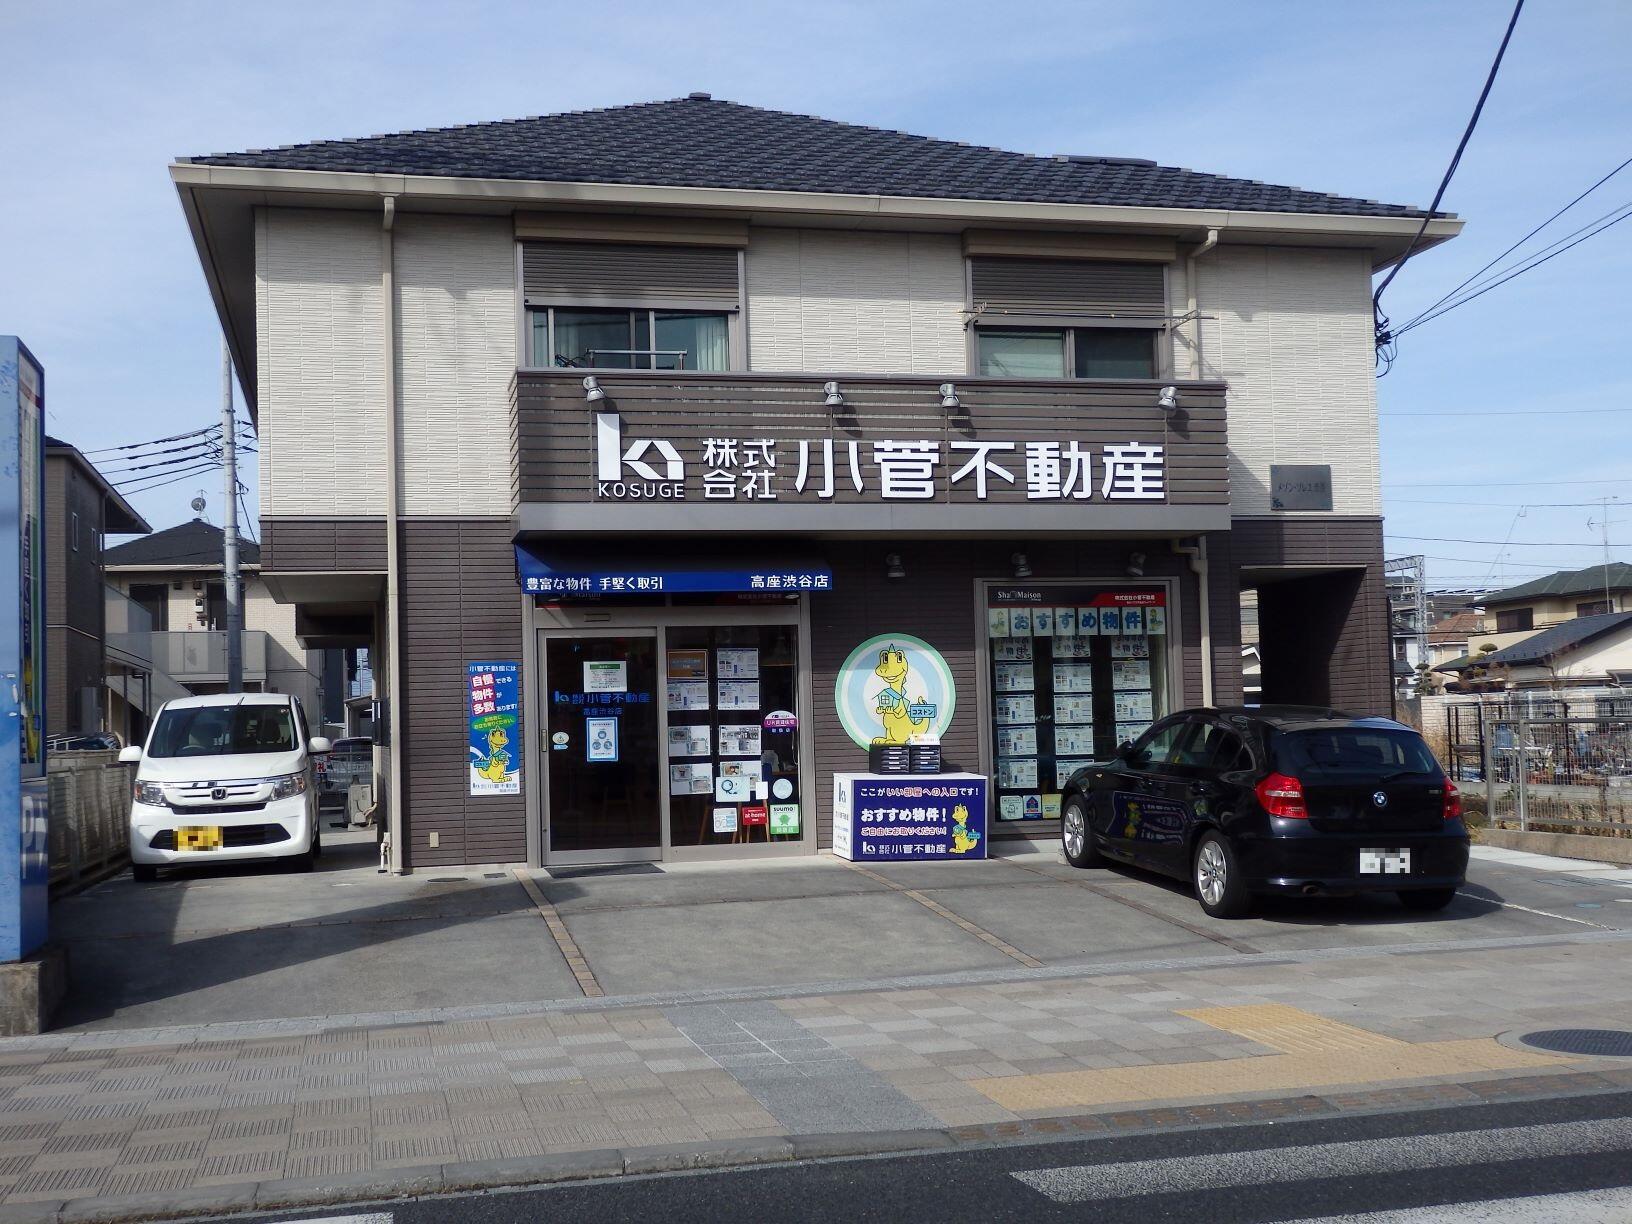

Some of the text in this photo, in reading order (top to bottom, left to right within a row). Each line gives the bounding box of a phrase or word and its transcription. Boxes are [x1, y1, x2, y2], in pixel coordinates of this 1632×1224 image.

[793, 437, 1166, 501] 小菅不動産
[597, 482, 685, 499] KOSUGE
[526, 576, 663, 591] 豊富な物件 手堅く取引
[750, 574, 829, 589] 高座渋谷店
[1014, 611, 1141, 630] おすすめ物件
[861, 807, 947, 823] おすすめ物件!
[892, 844, 947, 854] 小菅不動産
